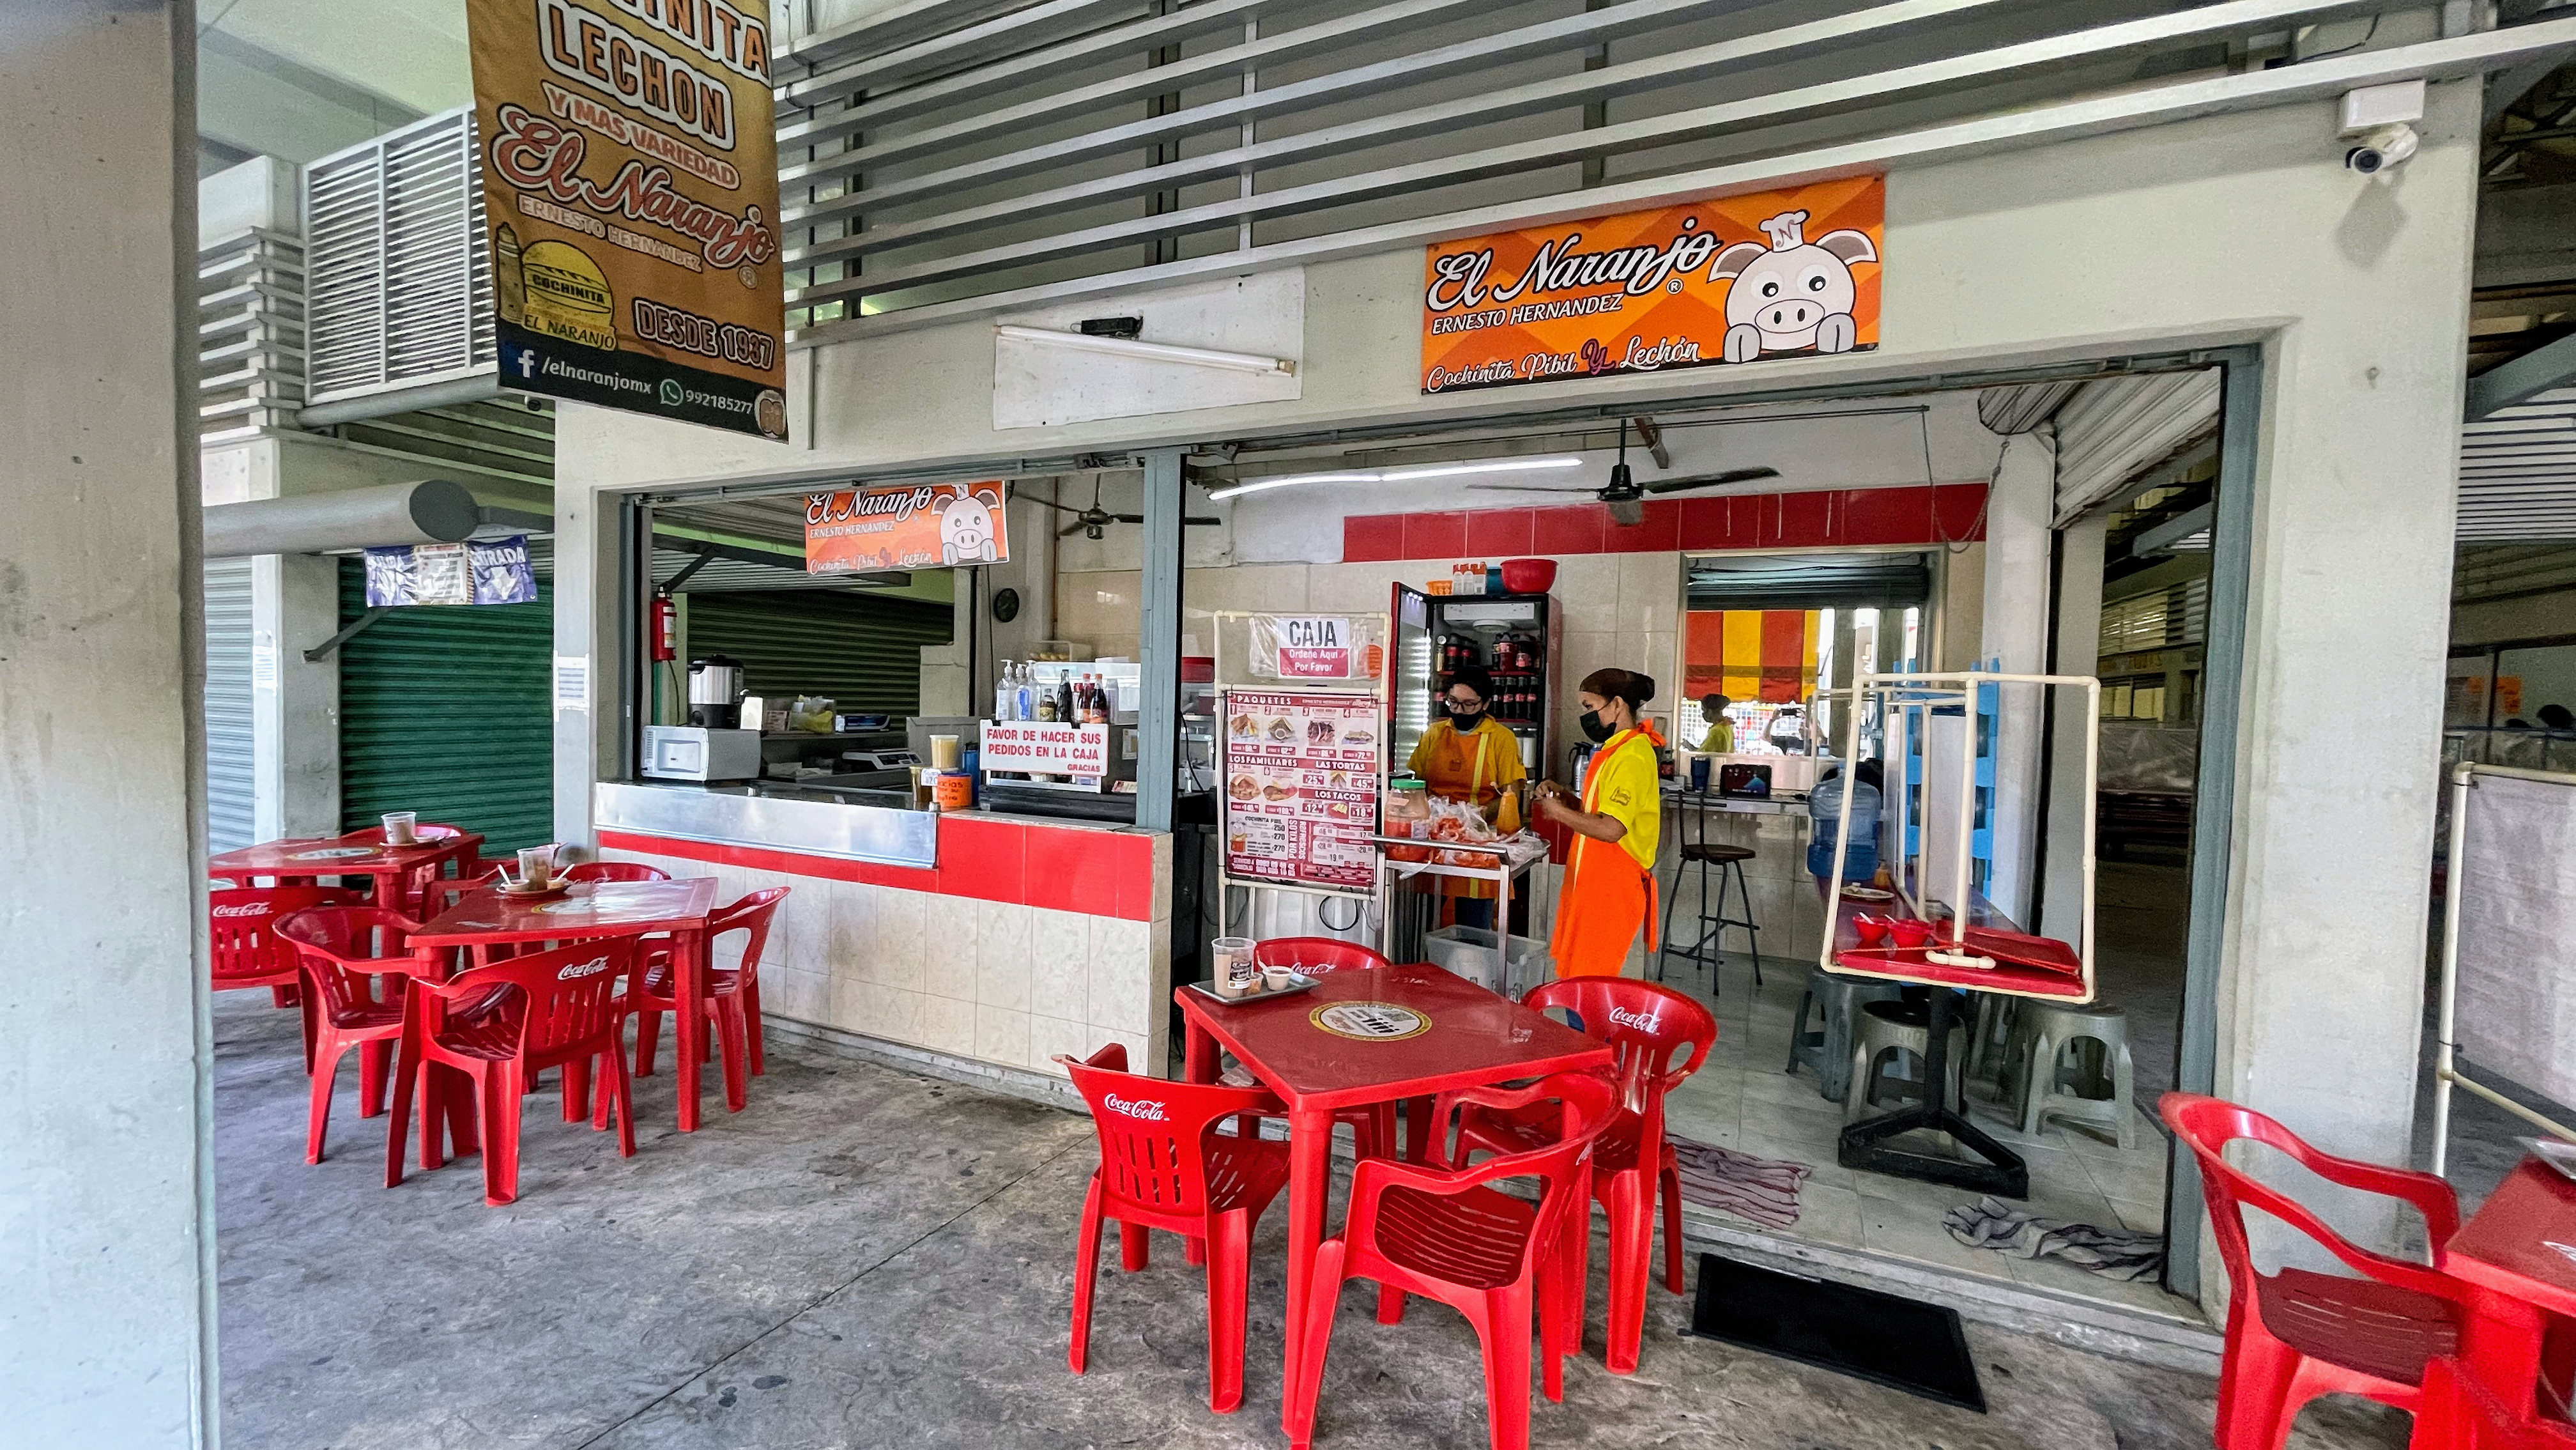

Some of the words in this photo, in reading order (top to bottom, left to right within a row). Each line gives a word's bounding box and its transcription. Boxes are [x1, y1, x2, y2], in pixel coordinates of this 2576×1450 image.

[547, 3, 727, 140] LECHON
[548, 89, 567, 112] Y
[575, 100, 629, 140] MAS
[631, 124, 737, 184] VARIEDAD
[496, 109, 580, 197] El
[584, 165, 774, 267] Naranjo
[520, 196, 606, 238] ERNESTO
[608, 226, 702, 273] HERNANDEZ
[1427, 249, 1491, 312] El
[1492, 218, 1720, 297] Naranjo
[532, 274, 606, 305] COCHINITA
[1432, 309, 1506, 336] ERNESTO
[1510, 294, 1623, 325] HERNANDEZ
[524, 314, 540, 332] EL
[546, 321, 615, 349] NARANJO
[639, 302, 716, 354] DESDE
[723, 327, 775, 369] 1937
[541, 357, 652, 394] /elnaranjomx
[1427, 360, 1514, 394] Cochinita
[1522, 351, 1577, 382] Pibil
[1620, 334, 1700, 371] Lechón
[806, 493, 835, 525] El
[837, 486, 934, 522] Naranjo
[809, 526, 843, 539] ERNESTO
[845, 520, 895, 536] HERNANDEZ
[1289, 621, 1338, 647] CAJA
[1289, 649, 1318, 659] Ordene
[1294, 661, 1308, 672] Por
[1310, 662, 1333, 672] Favor
[1237, 695, 1291, 706] PAQUETES
[986, 729, 1018, 741] FAVOR
[1023, 730, 1036, 741] DE
[1041, 731, 1075, 743] HACER
[1080, 732, 1101, 745] SUS
[988, 744, 1031, 757] PEDIDOS
[1036, 746, 1049, 757] EN
[1054, 747, 1067, 759] LA
[1073, 748, 1099, 760] CAJA
[1229, 755, 1245, 764] LOS
[1246, 757, 1298, 767] FAMILIARES
[1067, 764, 1101, 773] GRACIAS
[1315, 760, 1331, 769] LAS
[1331, 761, 1365, 771] TORTAS
[1315, 790, 1331, 799] LOS
[1333, 791, 1361, 801] TACOS
[1289, 819, 1298, 841] KILOS
[1288, 842, 1297, 859] POR
[212, 901, 272, 918] Coca-Cola
[558, 955, 610, 980] Coca-Cola
[1104, 1092, 1167, 1121] Coca-Cola
